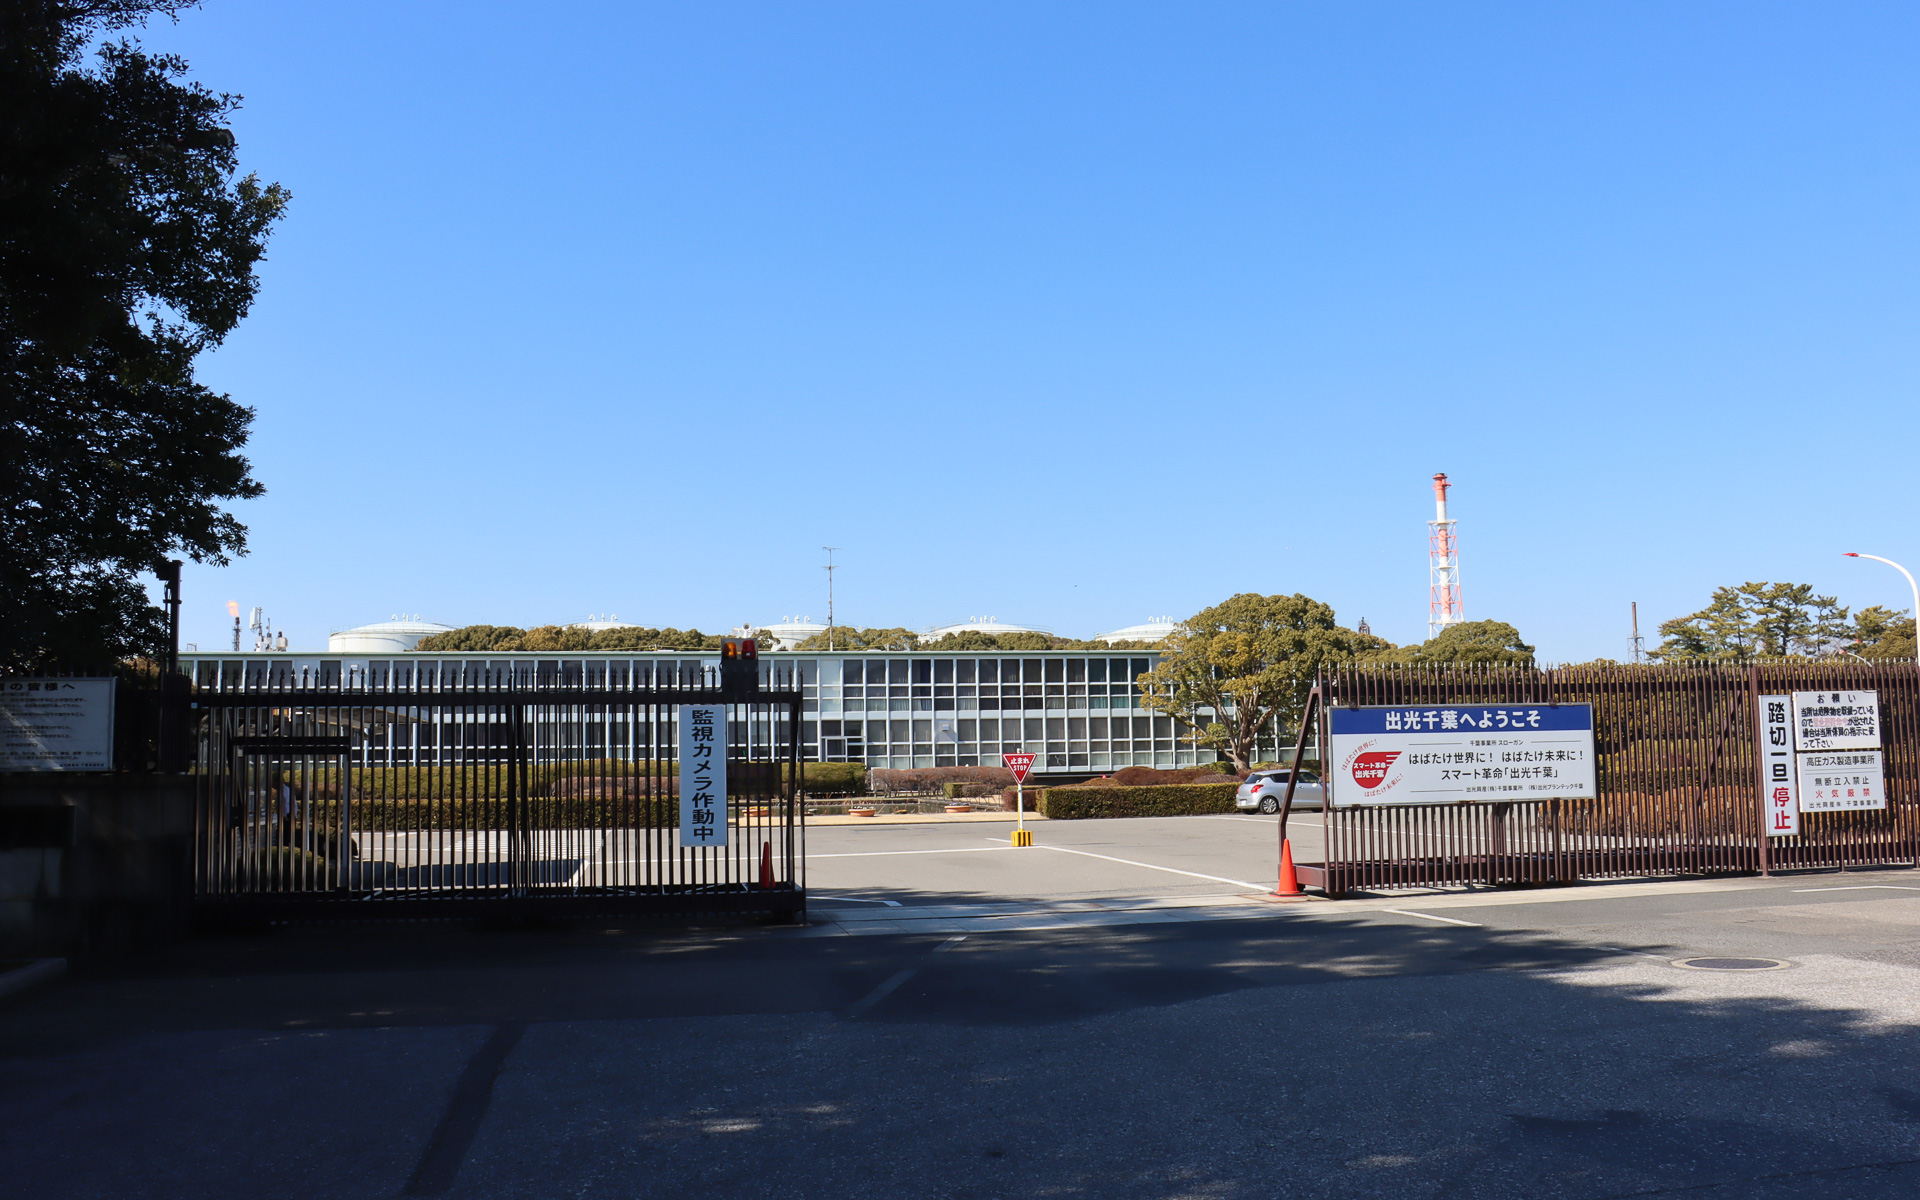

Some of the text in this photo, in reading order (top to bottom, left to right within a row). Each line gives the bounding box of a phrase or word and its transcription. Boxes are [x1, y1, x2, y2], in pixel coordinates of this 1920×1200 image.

[1817, 693, 1856, 703] お願い
[1385, 709, 1541, 731] 出光千葉へようこそ
[1803, 738, 1834, 749] って下さい
[1409, 750, 1584, 765] はばたけ世界に！ はばたけ未来に！
[1806, 755, 1875, 767] 高圧ガス製造事業所
[1767, 702, 1791, 830] 踏切一旦停止
[692, 709, 715, 842] 監視カメラ作動中
[1354, 769, 1385, 779] 出光千葉
[1441, 766, 1558, 780] スマート革命「出光千葉」
[1815, 776, 1869, 787] 無断立入禁止
[1815, 788, 1870, 799] 火気厳禁
